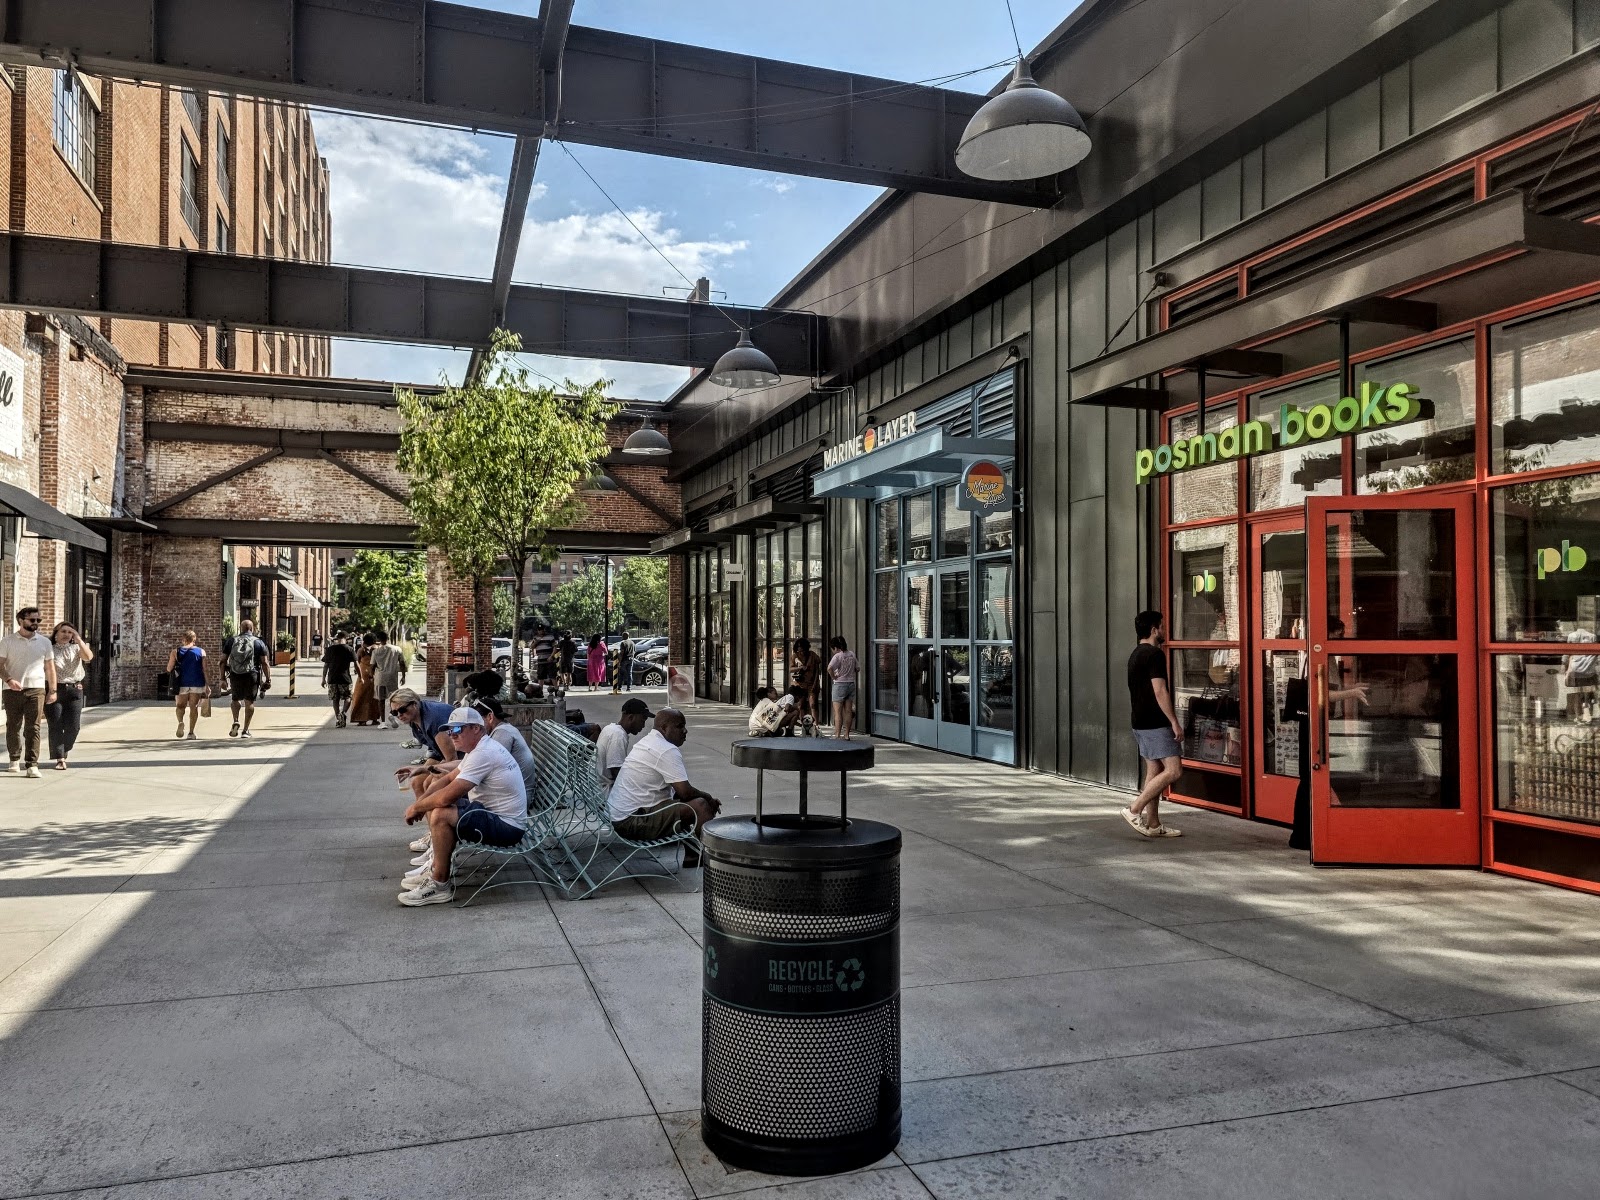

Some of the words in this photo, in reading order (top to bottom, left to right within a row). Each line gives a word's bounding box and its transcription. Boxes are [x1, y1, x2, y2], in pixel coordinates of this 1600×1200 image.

[824, 435, 863, 471] MARINE
[877, 411, 916, 447] LAYER
[1136, 420, 1271, 484] posman
[1280, 381, 1420, 446] books
[966, 478, 998, 498] Marine
[983, 490, 1006, 508] Layer
[1538, 540, 1587, 579] pb
[1193, 570, 1216, 597] pb
[769, 959, 833, 981] RECYCLE
[768, 983, 783, 992] CANS
[787, 984, 811, 993] BOTTLES
[815, 984, 833, 992] GLASS
